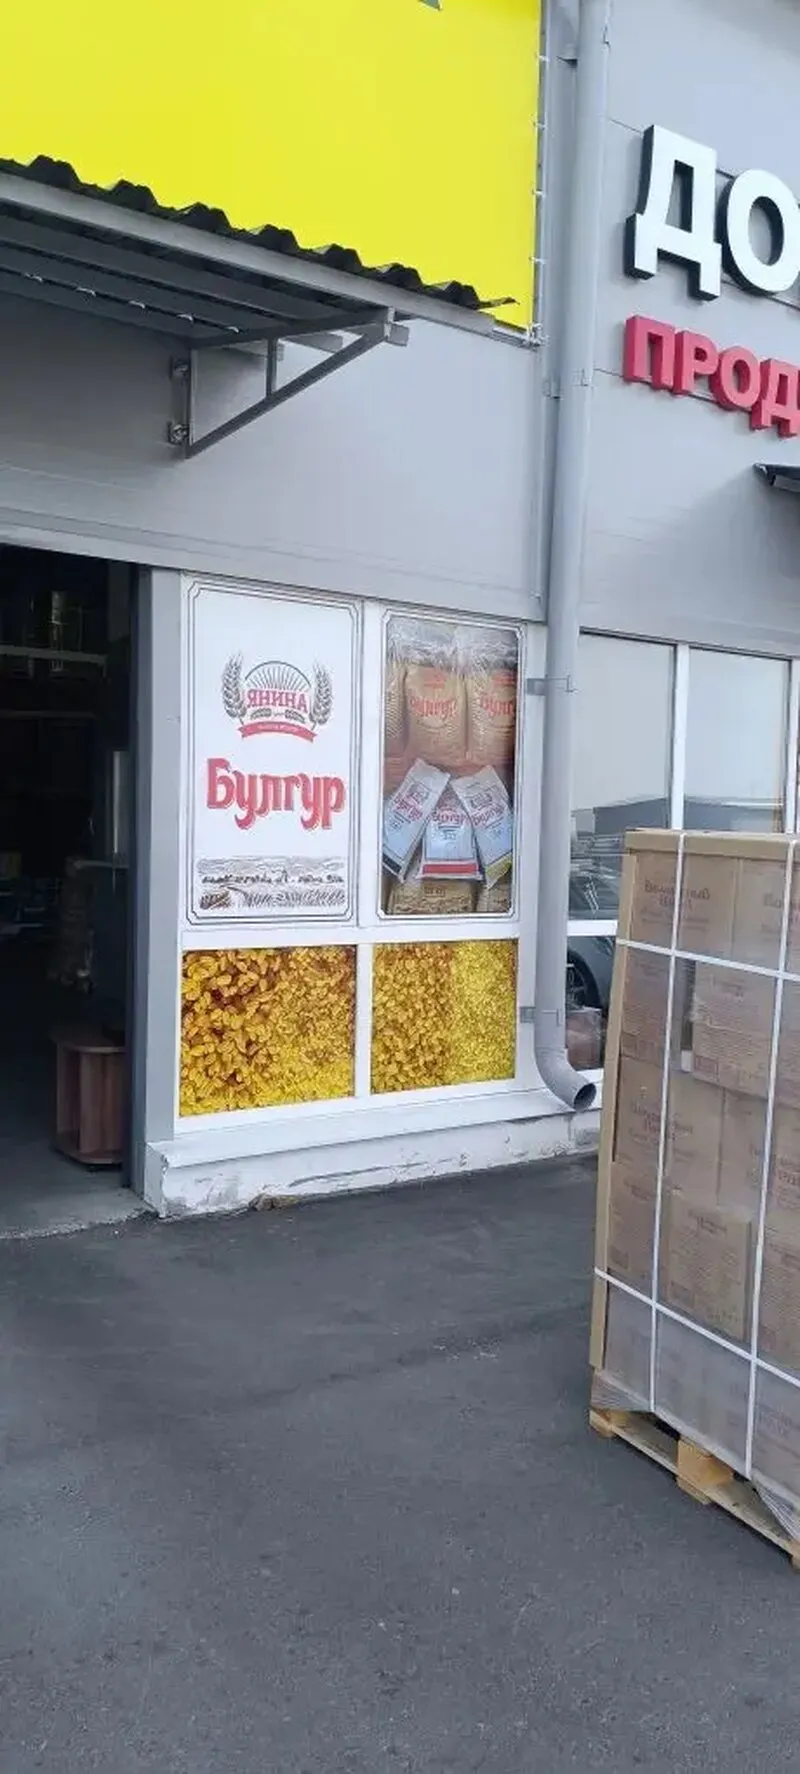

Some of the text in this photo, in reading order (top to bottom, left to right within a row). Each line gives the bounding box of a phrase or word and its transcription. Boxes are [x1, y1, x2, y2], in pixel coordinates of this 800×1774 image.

[625, 124, 800, 300] ДО
[247, 688, 308, 714] ЯНИНА
[206, 757, 346, 831] Булгур
